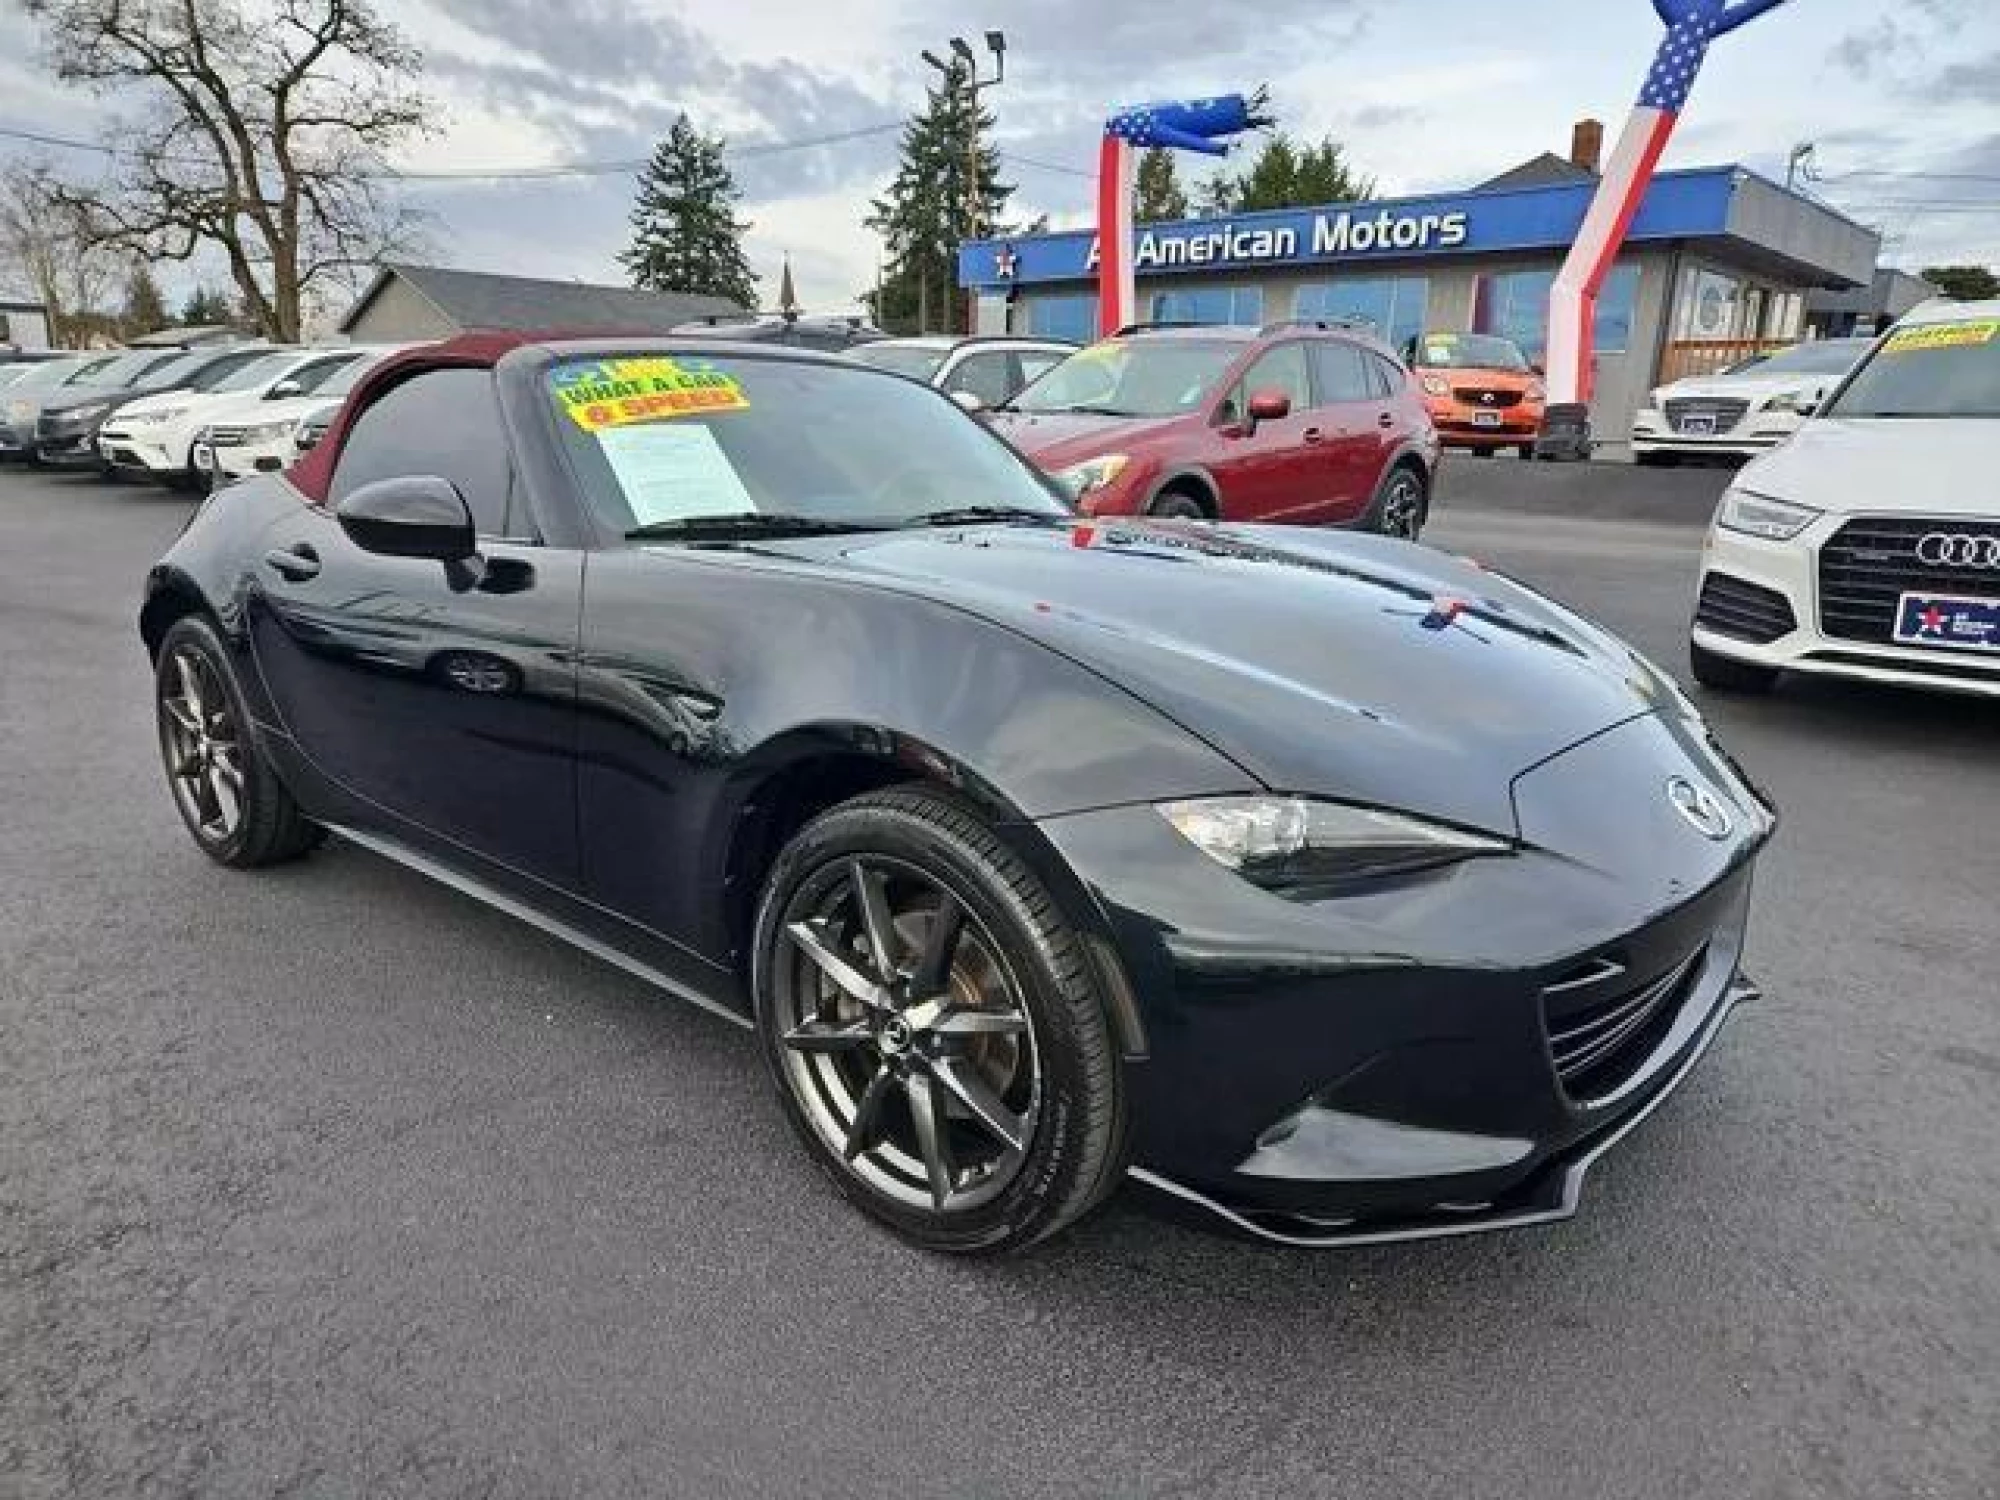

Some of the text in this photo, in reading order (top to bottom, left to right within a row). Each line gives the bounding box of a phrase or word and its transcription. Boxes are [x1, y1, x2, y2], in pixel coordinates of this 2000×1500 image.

[1136, 224, 1295, 266] American
[1312, 209, 1466, 253] Motors
[564, 380, 642, 404] WHAT
